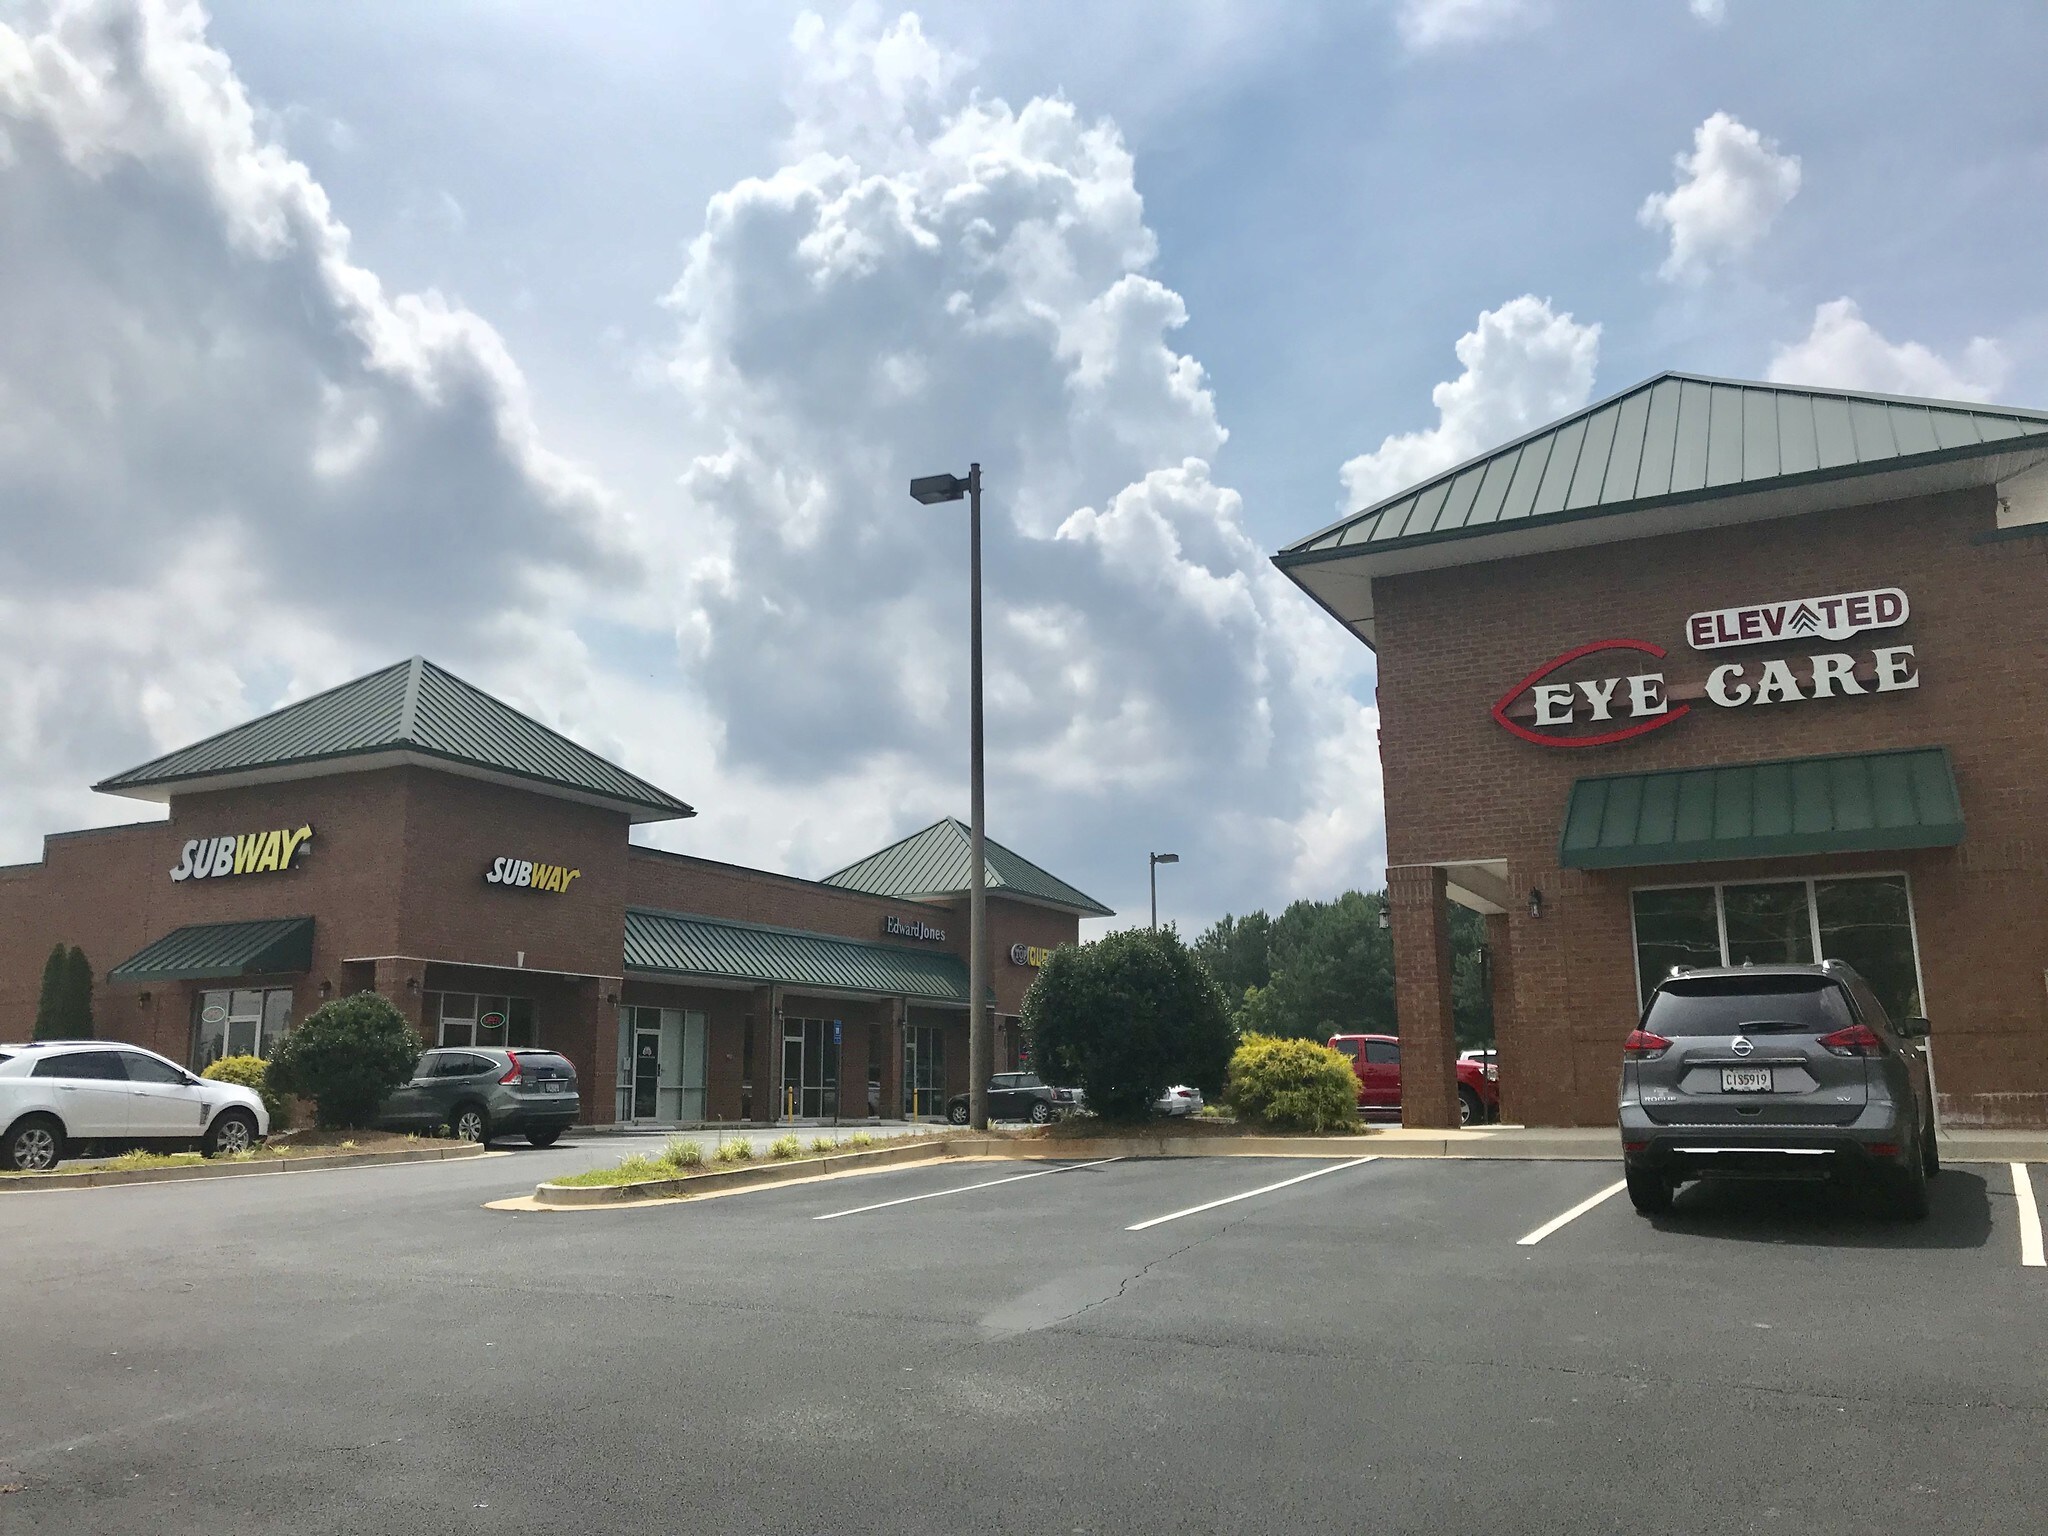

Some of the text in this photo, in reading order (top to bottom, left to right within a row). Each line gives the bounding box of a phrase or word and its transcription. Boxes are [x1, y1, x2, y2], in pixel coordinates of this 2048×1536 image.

[1532, 645, 1920, 727] EYE CARE
[169, 824, 312, 882] SUBWAY
[486, 857, 580, 893] SUBWAY
